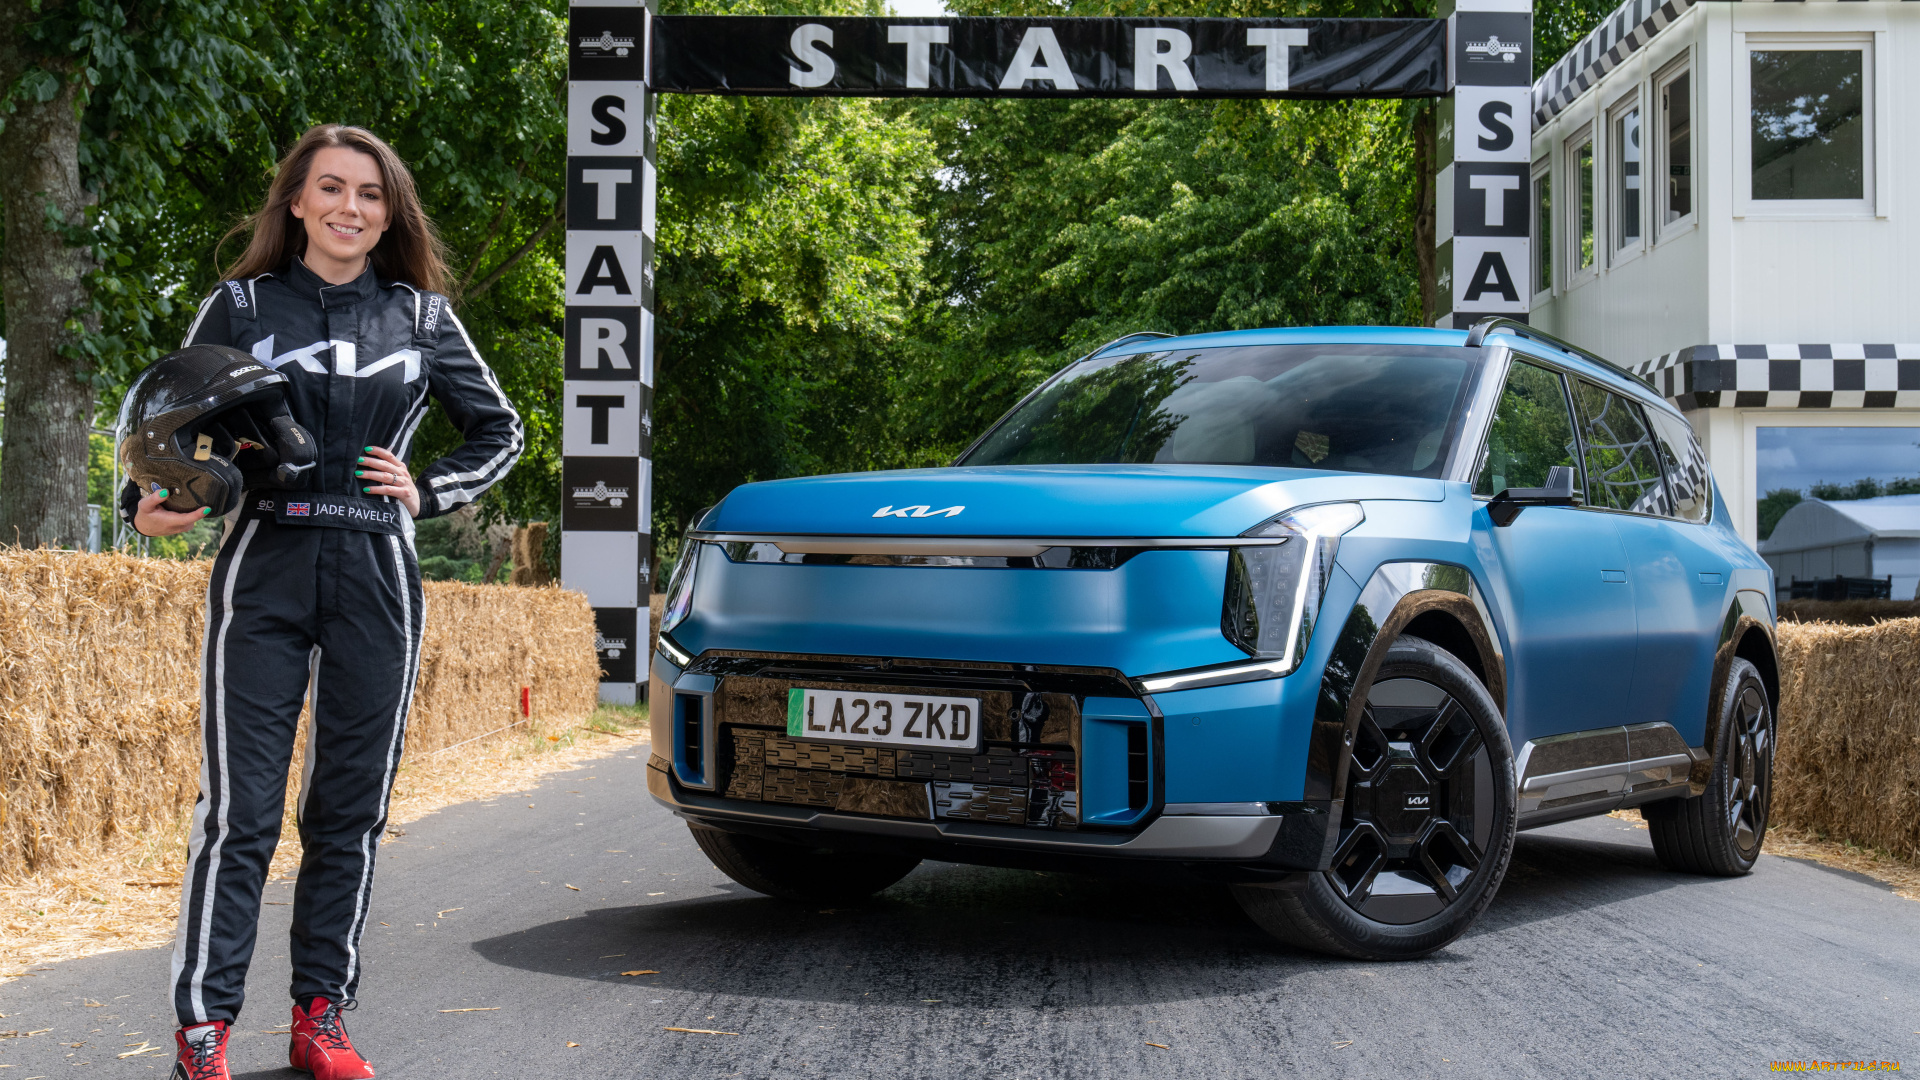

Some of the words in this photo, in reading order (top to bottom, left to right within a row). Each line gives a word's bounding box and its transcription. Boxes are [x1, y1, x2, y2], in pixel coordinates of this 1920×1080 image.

[790, 23, 1309, 91] START
[1463, 101, 1520, 335] STA
[576, 94, 633, 445] START
[425, 295, 439, 330] sparco
[314, 503, 346, 516] JADE
[348, 507, 396, 524] PAVELEY
[872, 505, 966, 518] KIA
[808, 695, 893, 736] LA23
[903, 702, 971, 741] ZKD
